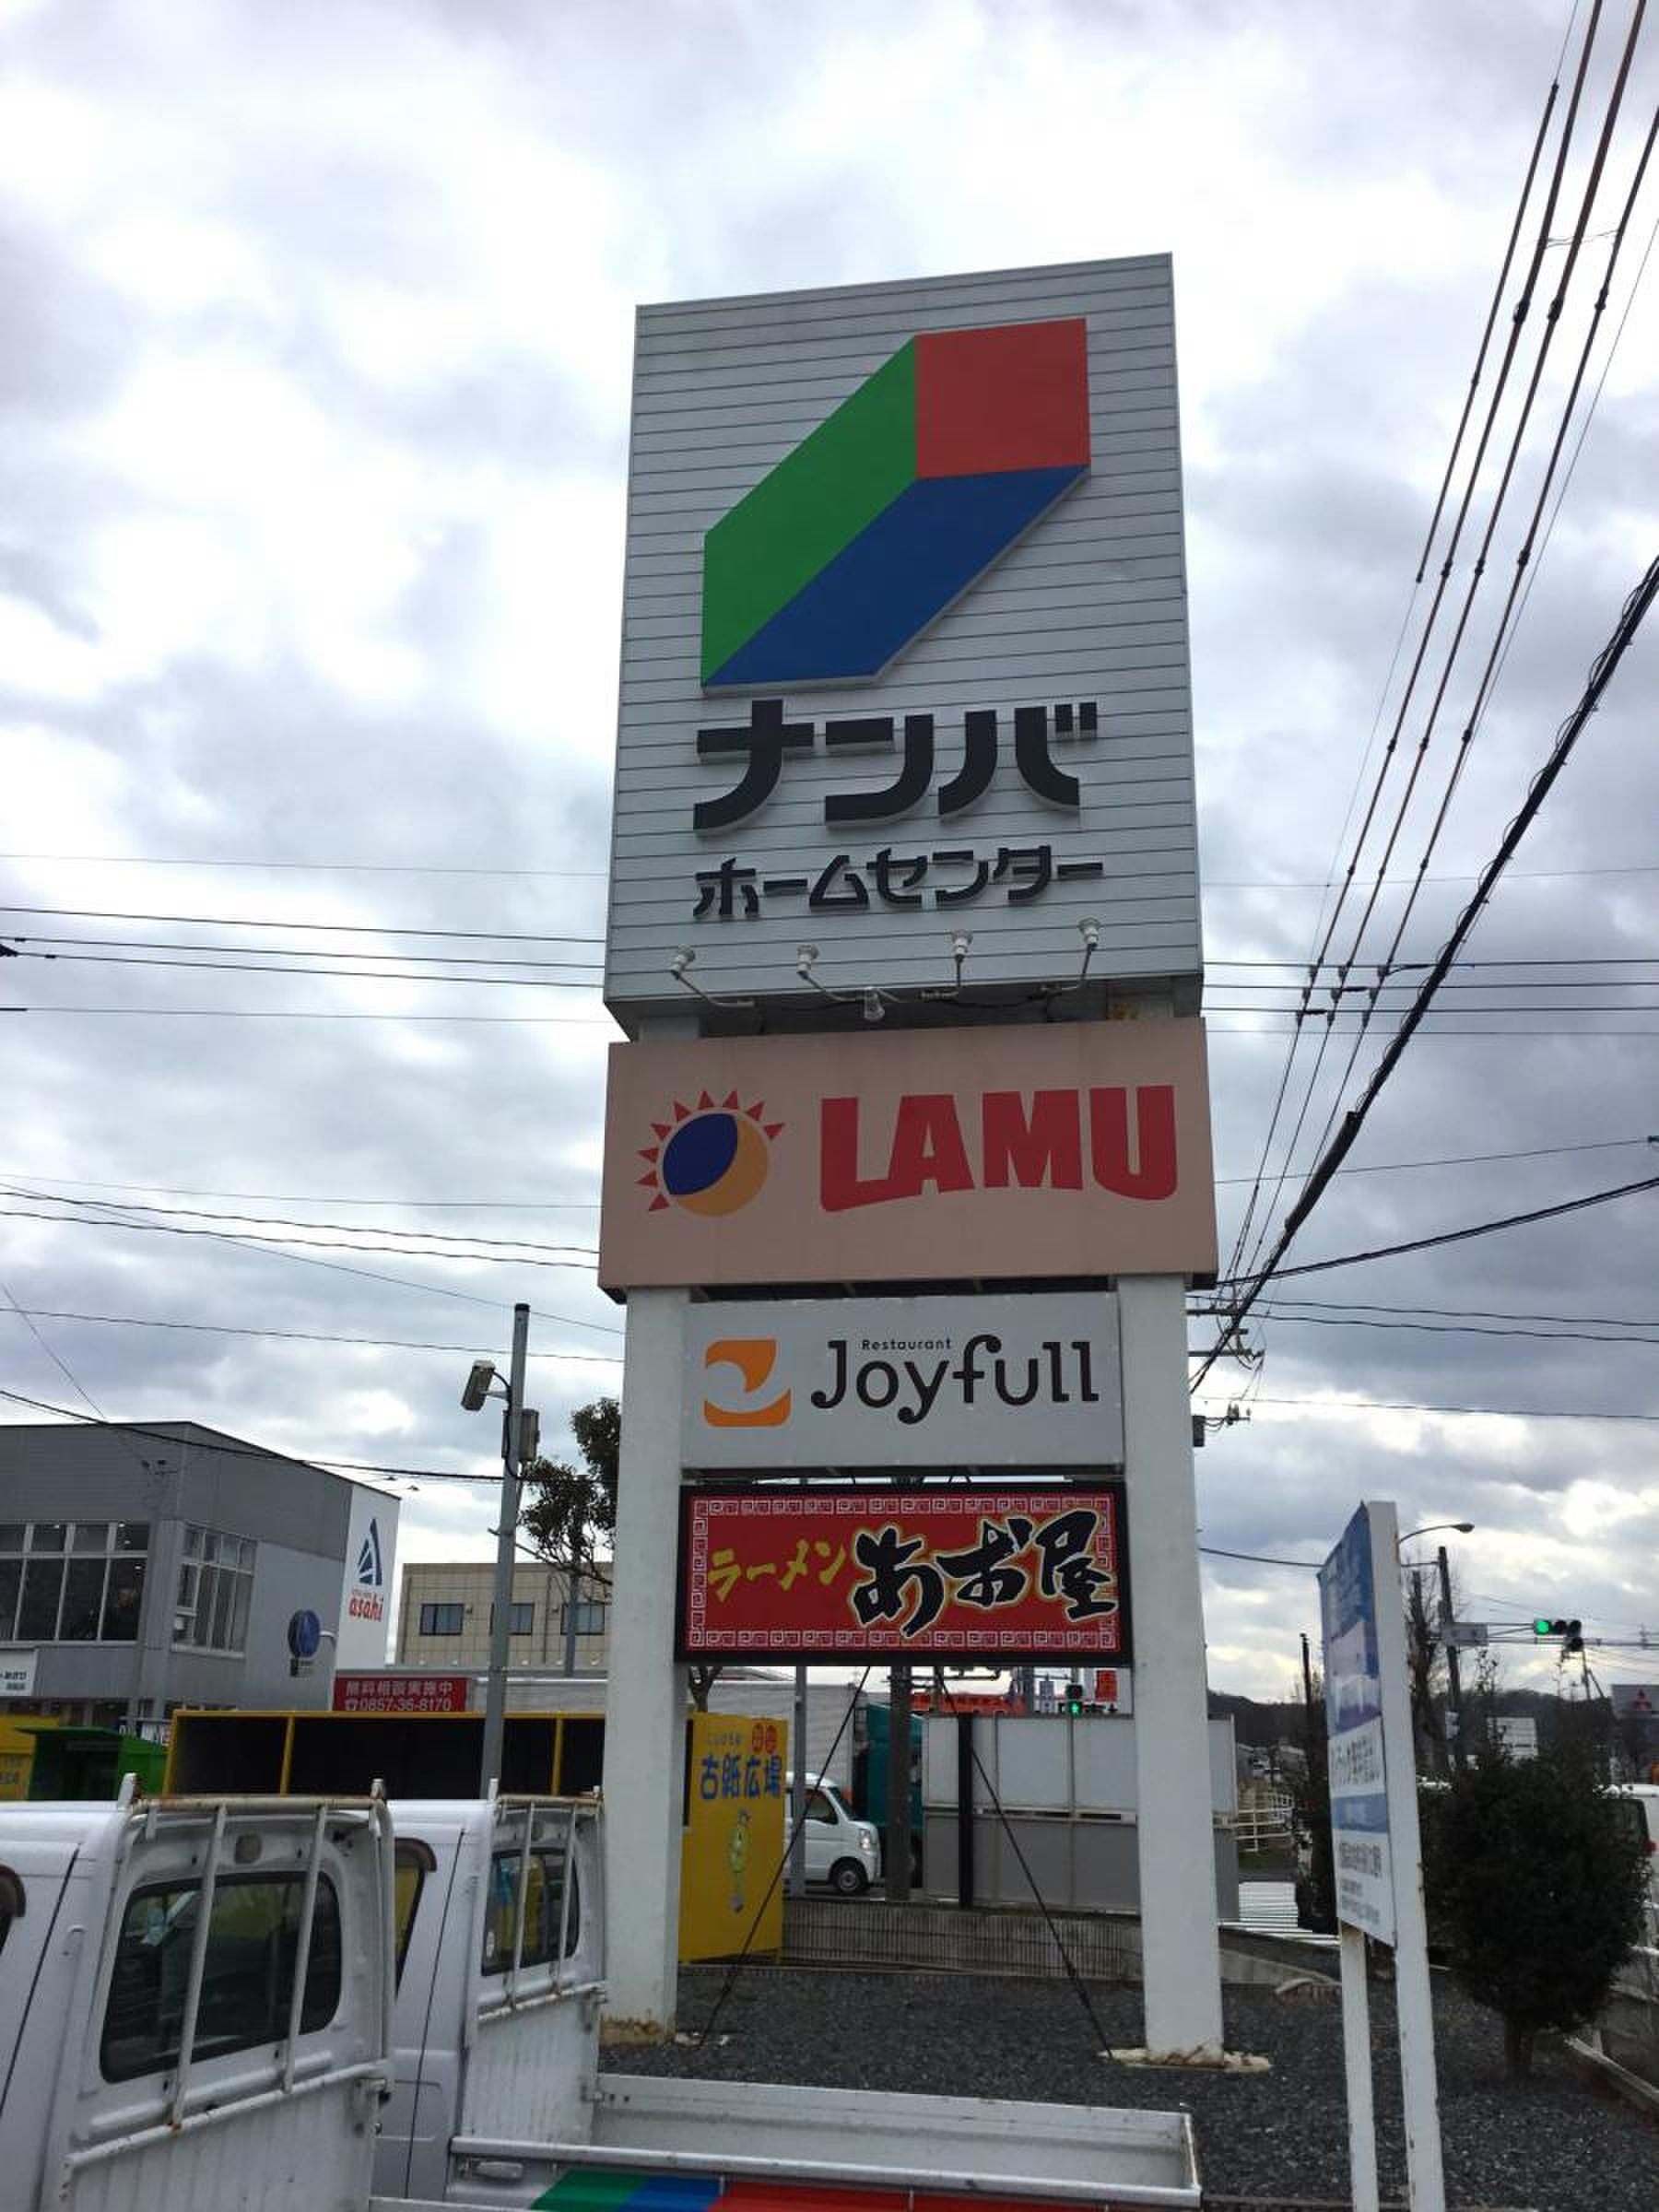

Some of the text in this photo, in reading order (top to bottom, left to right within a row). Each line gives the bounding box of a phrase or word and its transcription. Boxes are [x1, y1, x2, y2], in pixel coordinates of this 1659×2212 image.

[693, 699, 1098, 830] ナンバ
[692, 844, 1103, 916] ホームセンター
[820, 1084, 1177, 1212] LAMU
[810, 1335, 1100, 1425] Joyfull
[861, 1338, 952, 1351] Restaurant
[708, 1539, 845, 1602] ラーメン
[350, 1594, 383, 1621] asahi
